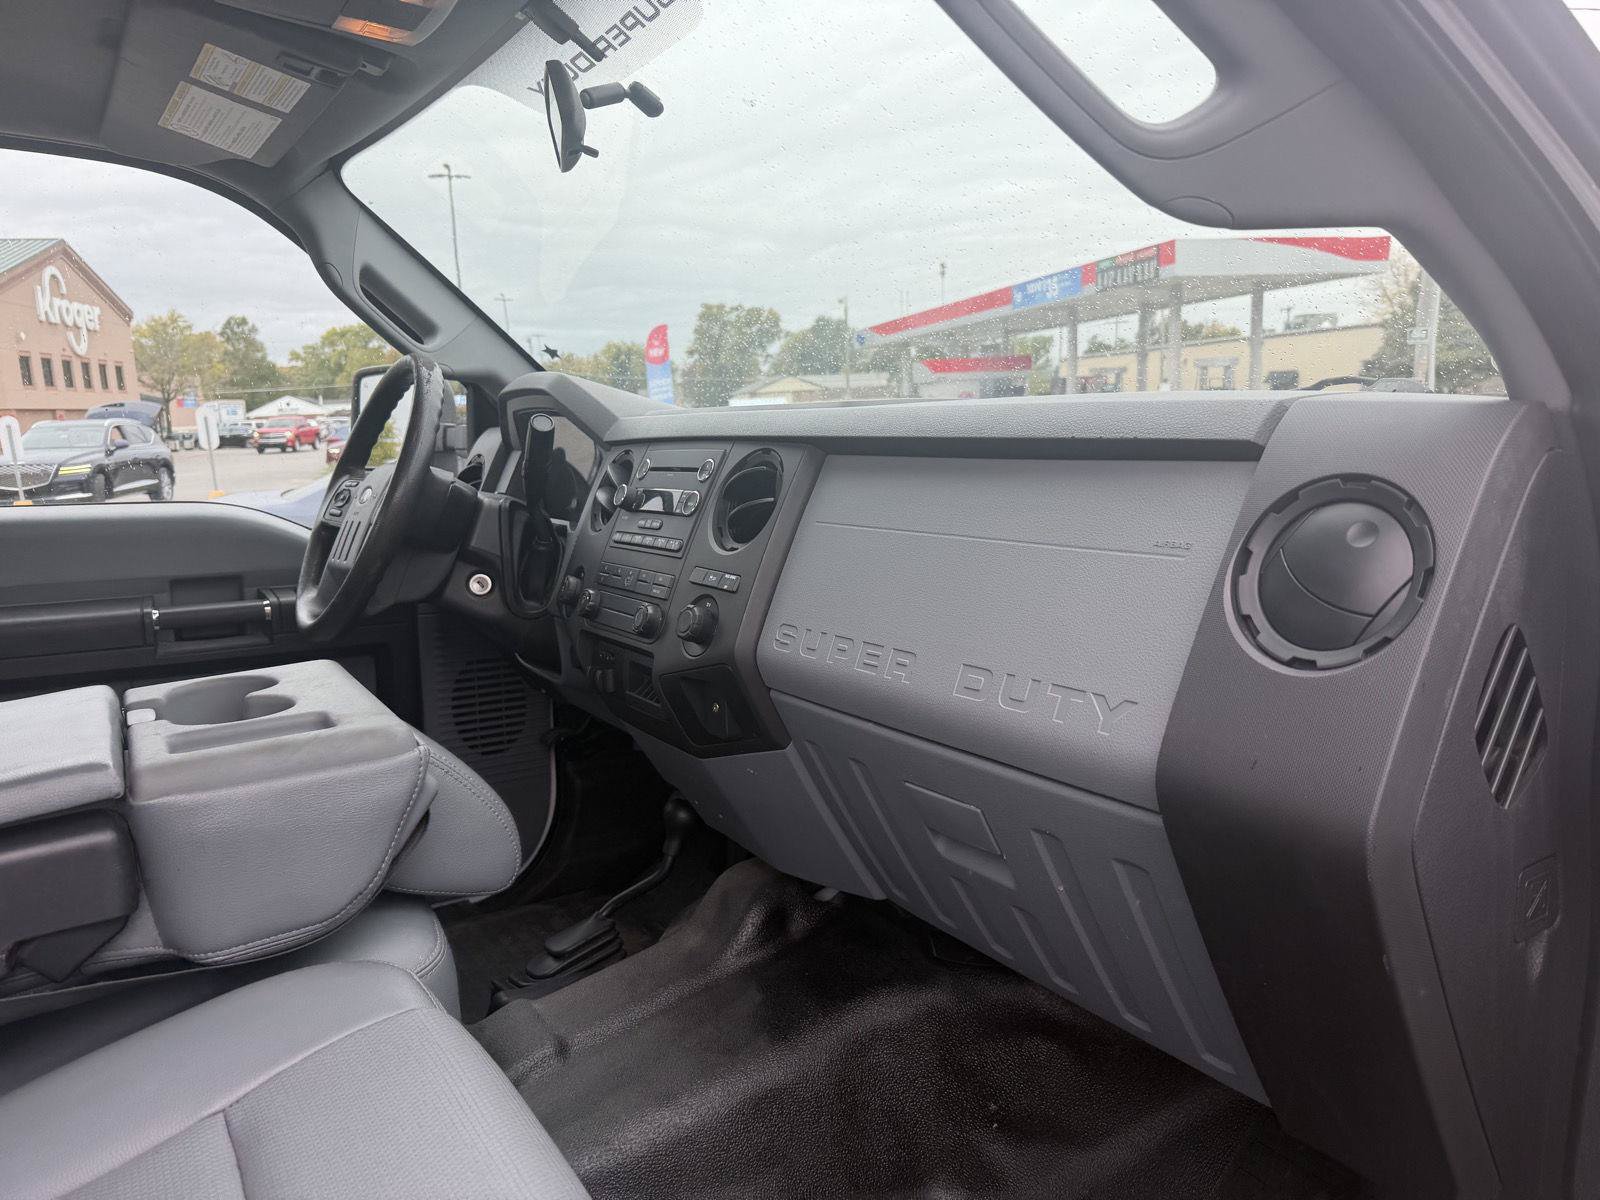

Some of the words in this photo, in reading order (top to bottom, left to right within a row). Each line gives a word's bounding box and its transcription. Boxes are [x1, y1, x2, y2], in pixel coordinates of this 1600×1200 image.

[34, 265, 101, 356] Kroger
[773, 623, 917, 684] SUPER
[953, 663, 1139, 736] DUTY
